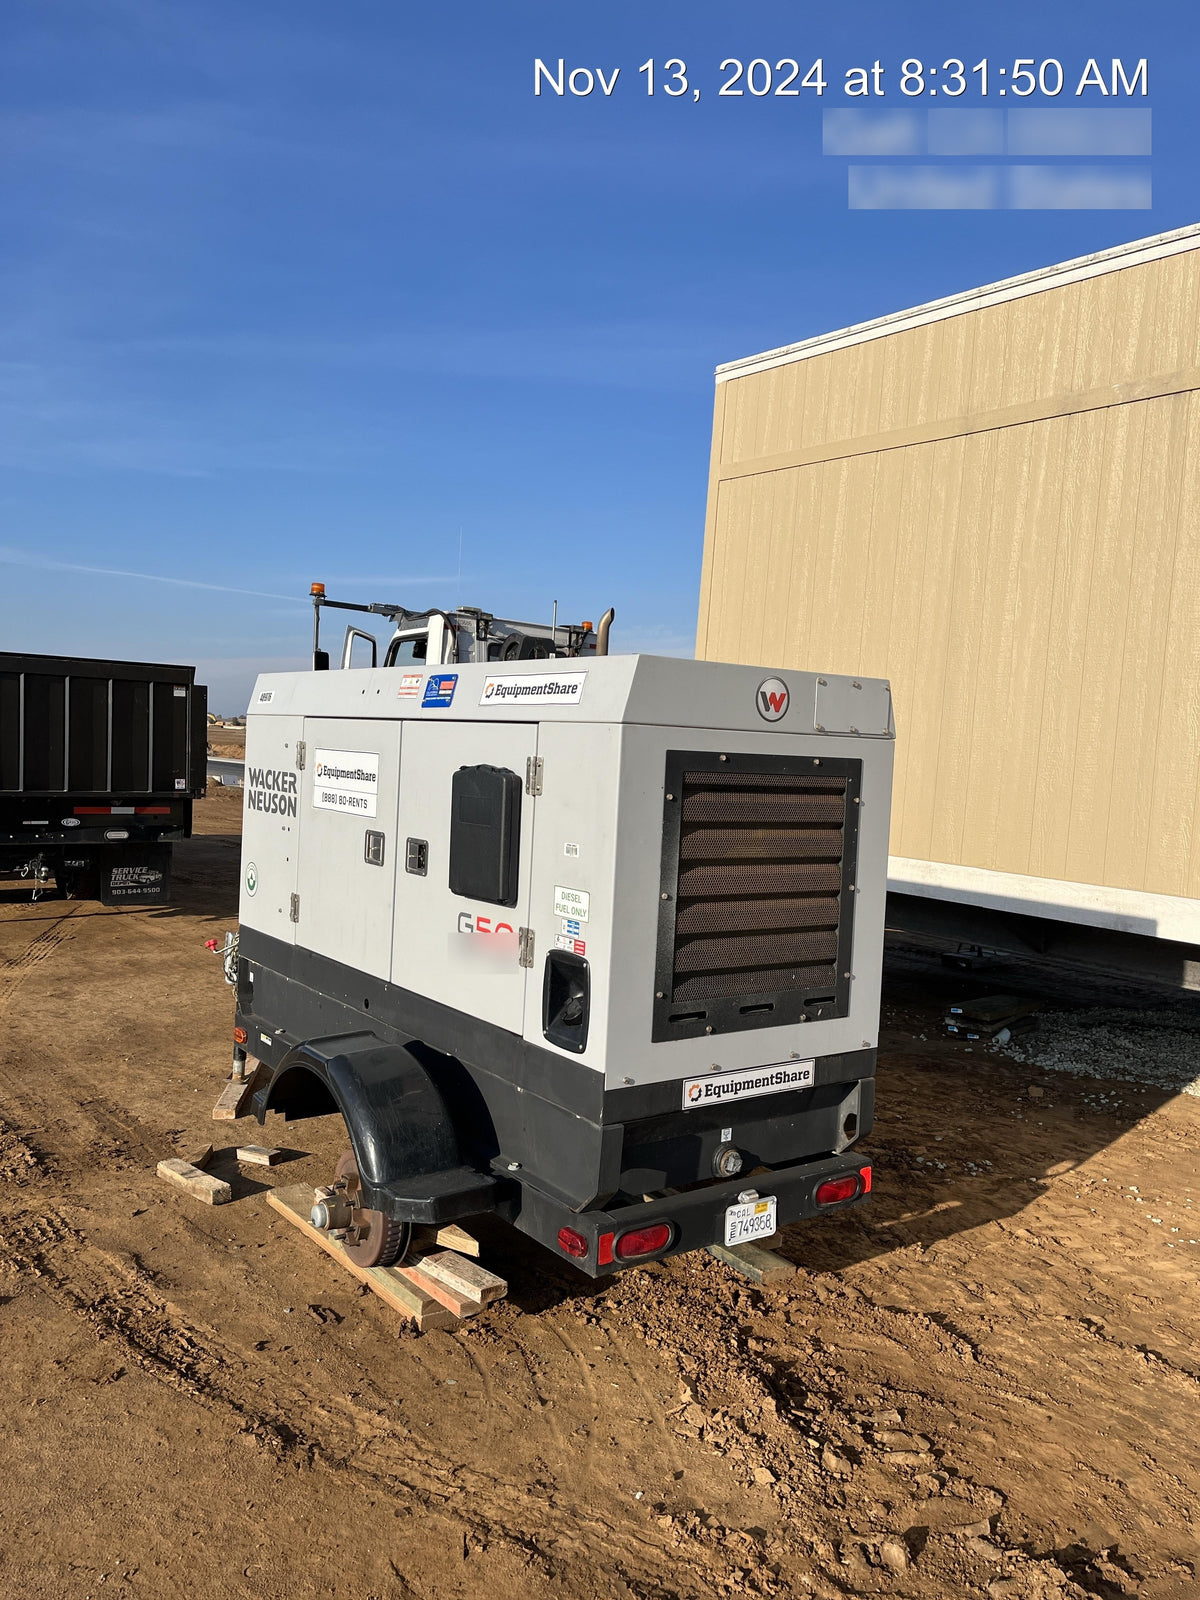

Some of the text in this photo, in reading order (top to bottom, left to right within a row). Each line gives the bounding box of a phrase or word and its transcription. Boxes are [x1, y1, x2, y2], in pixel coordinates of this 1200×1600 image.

[494, 682, 578, 698] EquipmentShare
[248, 767, 298, 794] WACKER
[323, 765, 377, 782] EquipmentShare
[248, 789, 298, 818] NEUSON
[321, 791, 338, 805] (888)
[111, 866, 149, 875] SERVICE
[111, 873, 139, 881] TRUCK
[561, 891, 582, 904] DIESEL
[555, 902, 587, 918] FUEL ONLY
[704, 1070, 810, 1098] EquipmentShare
[736, 1208, 750, 1218] CAL
[738, 1214, 771, 1236] 749358
